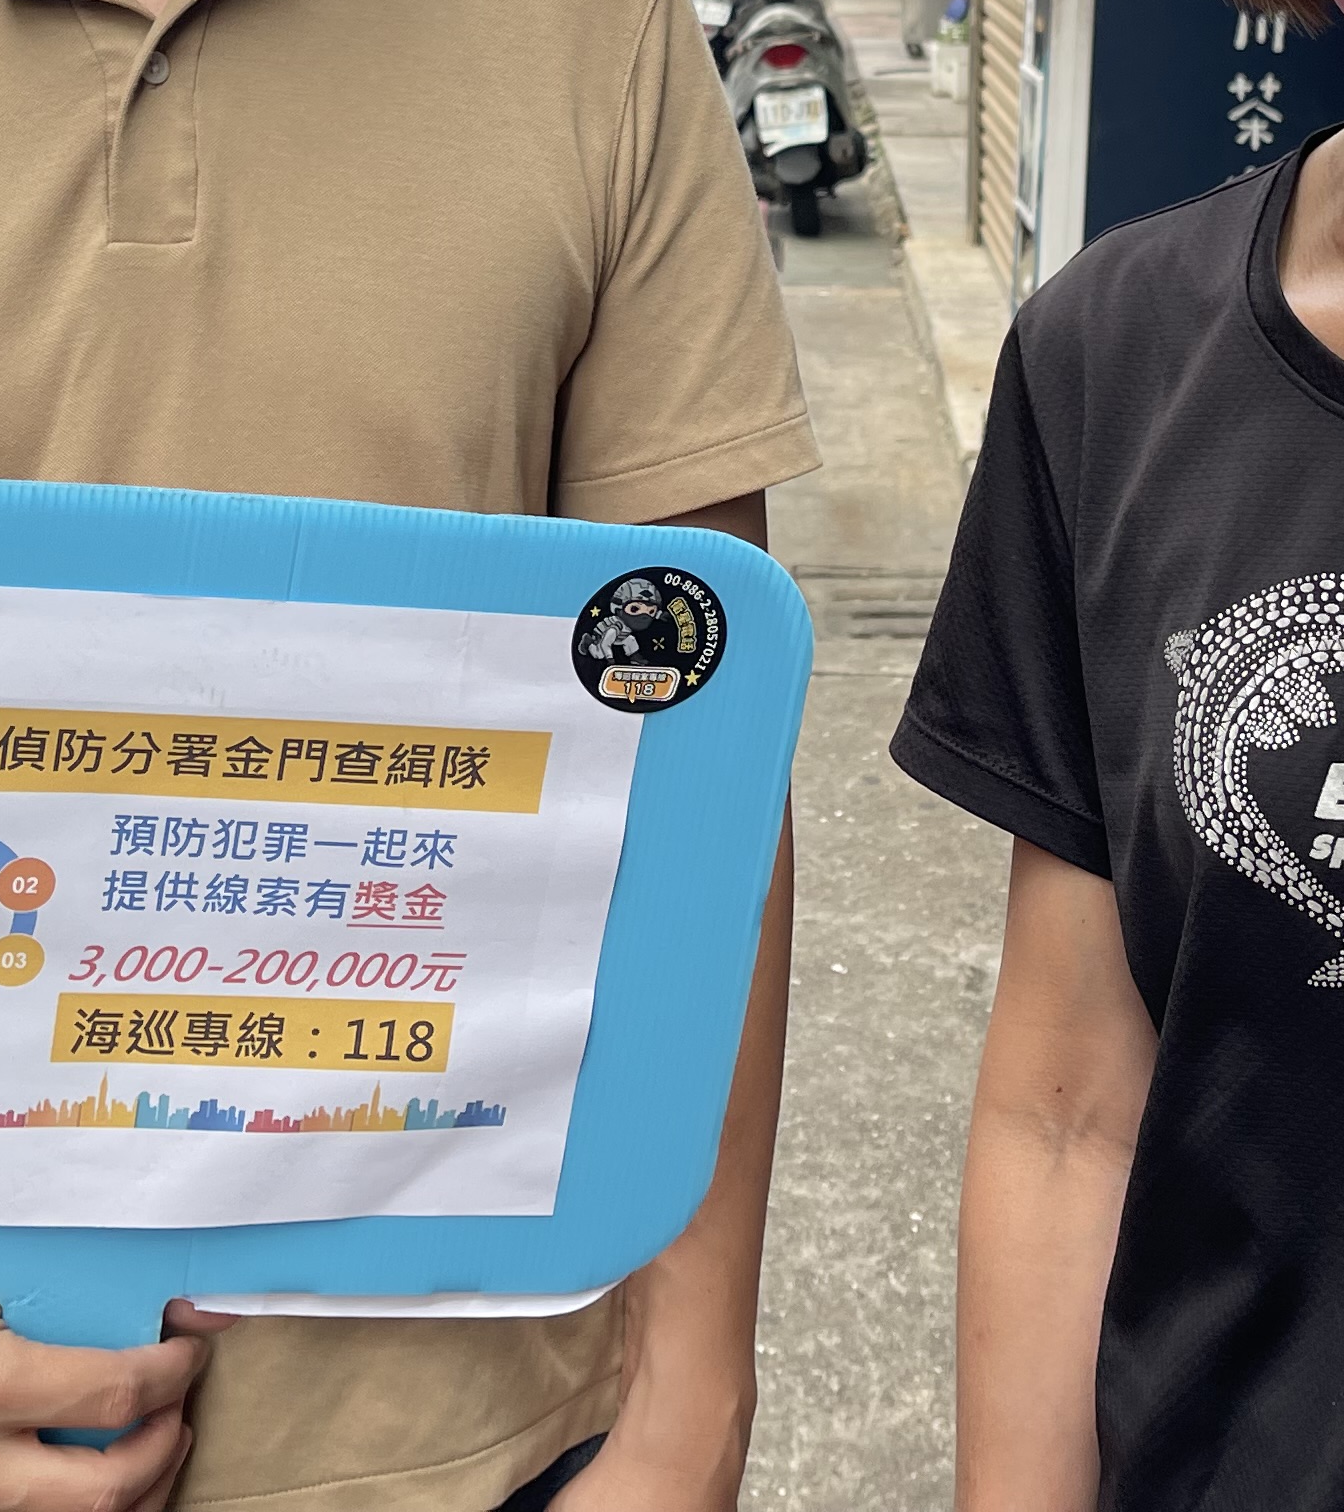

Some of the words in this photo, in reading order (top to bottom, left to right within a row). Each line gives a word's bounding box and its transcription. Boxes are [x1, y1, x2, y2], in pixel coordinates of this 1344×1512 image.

[623, 682, 655, 696] 118
[109, 813, 458, 871] 預防犯罪一起來
[11, 876, 39, 895] 02
[101, 869, 448, 922] 提供線索有獎金
[0, 951, 28, 970] 03
[67, 944, 468, 993] 3,000-200,000元
